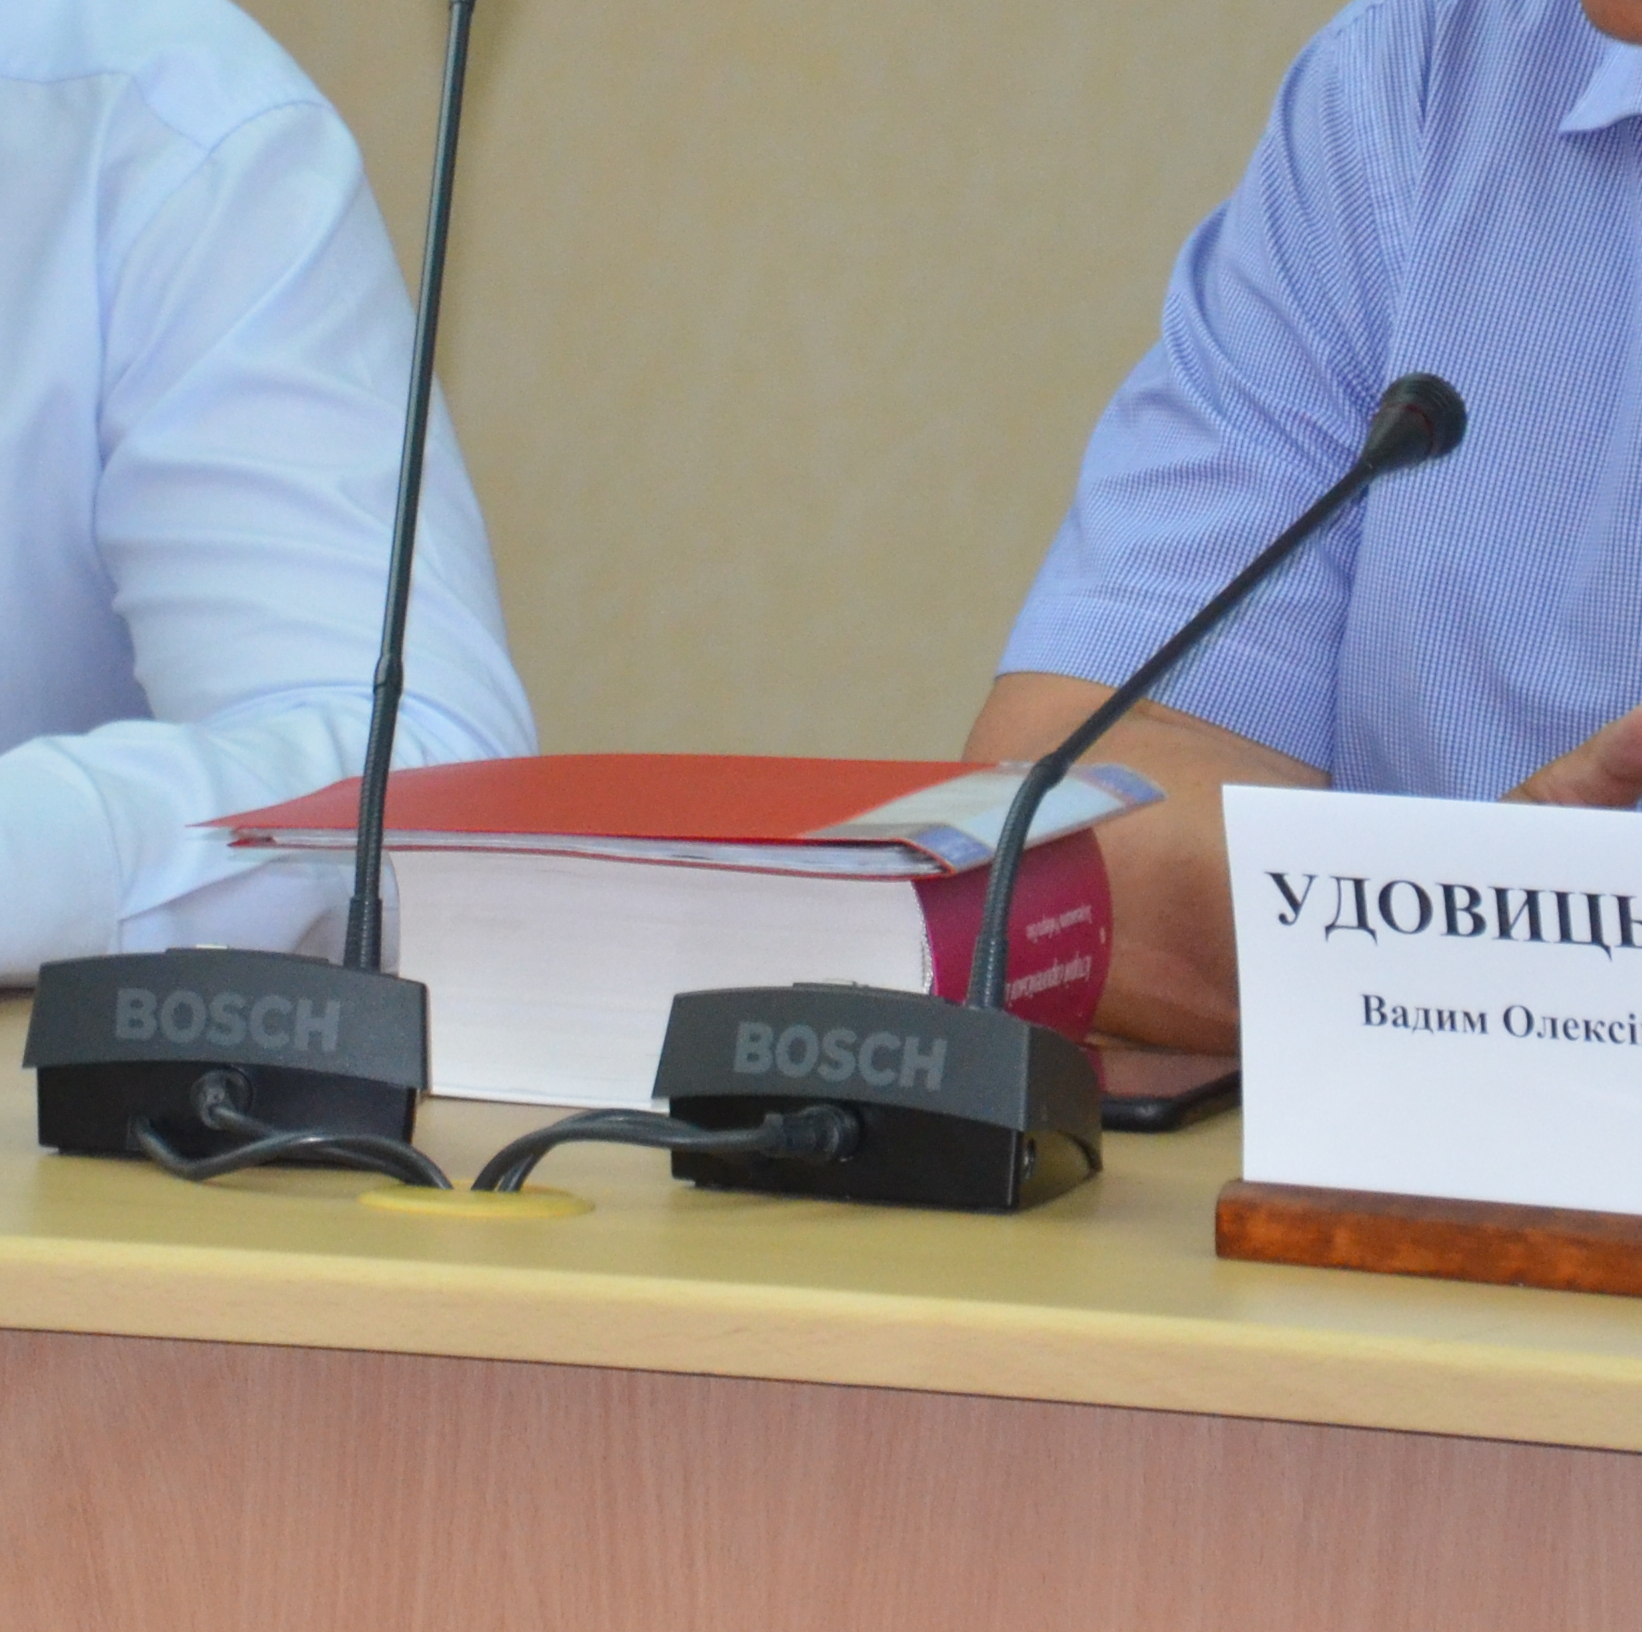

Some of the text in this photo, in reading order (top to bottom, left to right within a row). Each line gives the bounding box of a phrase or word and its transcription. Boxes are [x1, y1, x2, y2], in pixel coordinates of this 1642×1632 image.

[115, 987, 341, 1052] BOSCH
[1361, 993, 1488, 1035] Вадим
[733, 1021, 948, 1092] BOSCH
